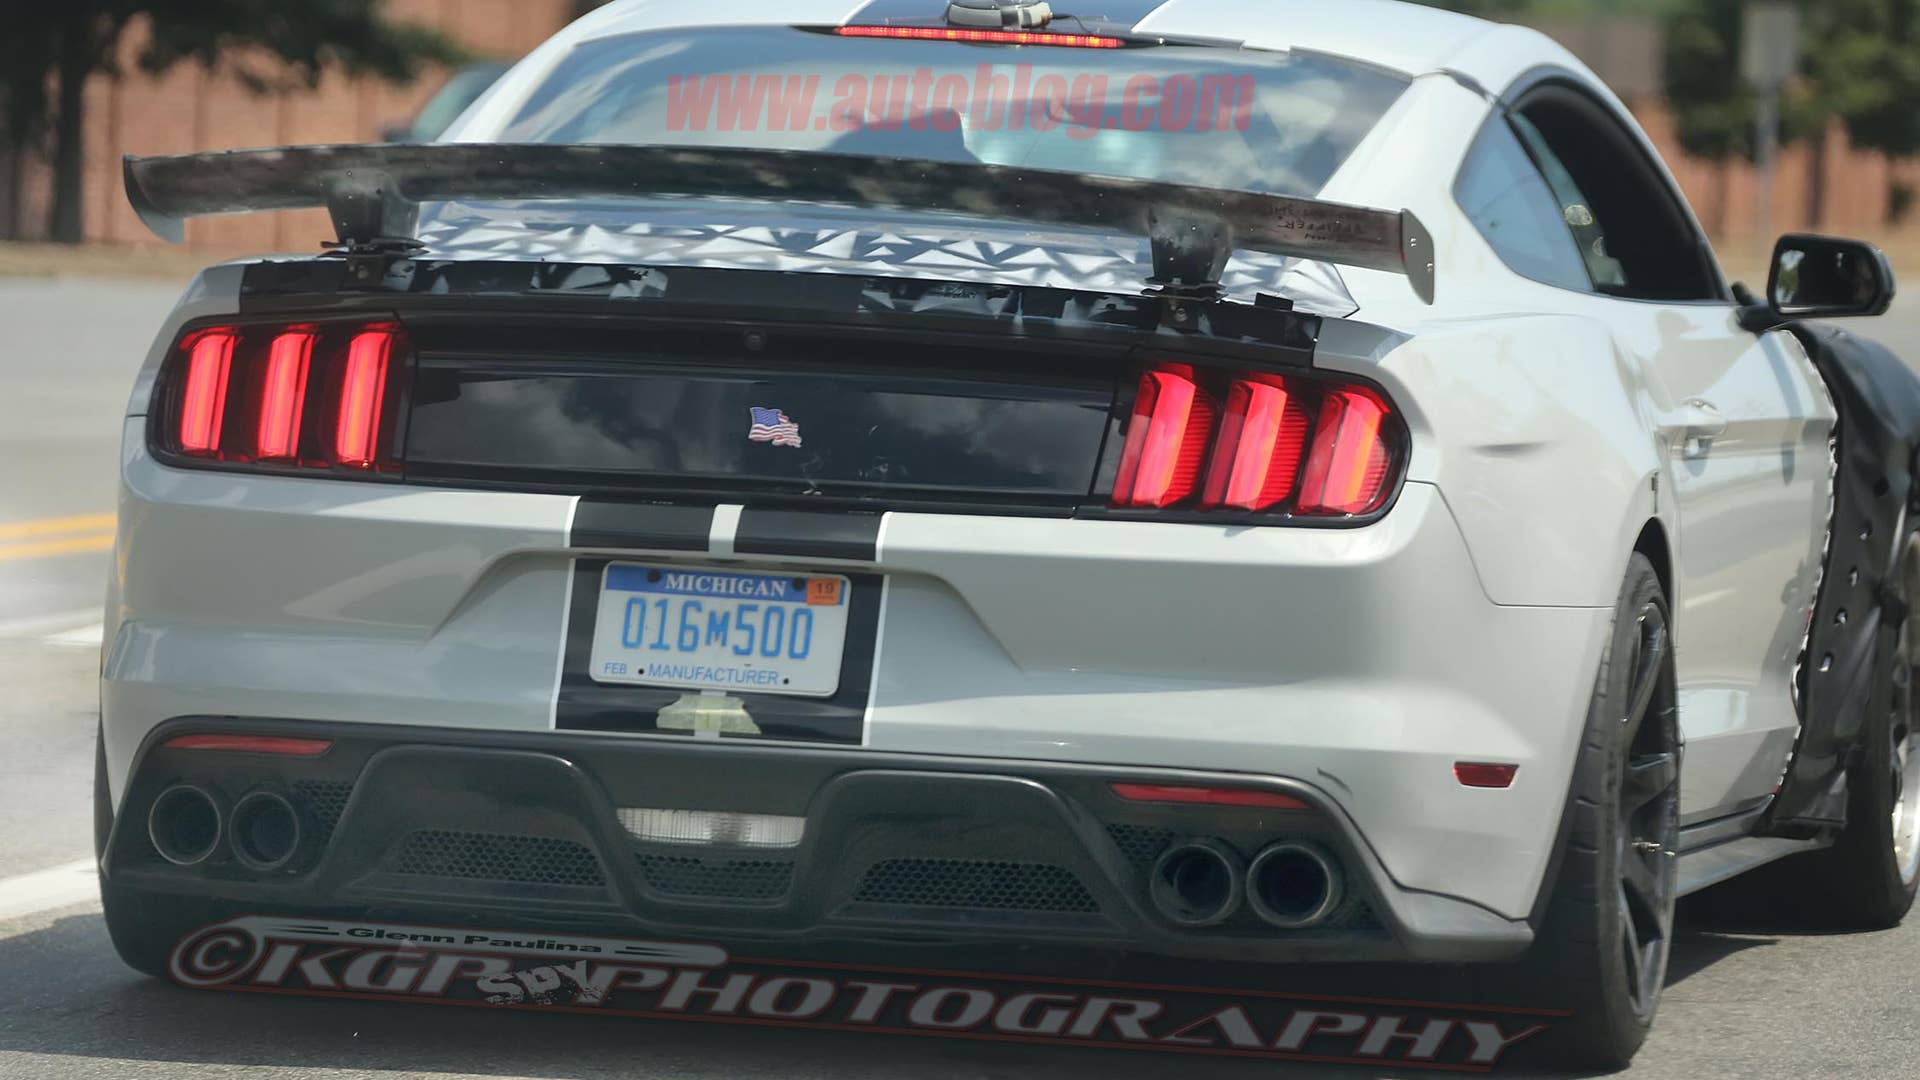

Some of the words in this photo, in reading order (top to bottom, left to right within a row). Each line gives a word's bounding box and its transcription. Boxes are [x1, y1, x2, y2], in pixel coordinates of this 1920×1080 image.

[664, 572, 788, 598] MICHIGAN
[815, 582, 835, 594] 19
[621, 596, 814, 660] 016M500
[604, 662, 628, 675] FEB
[647, 663, 780, 686] MANUFACTURER
